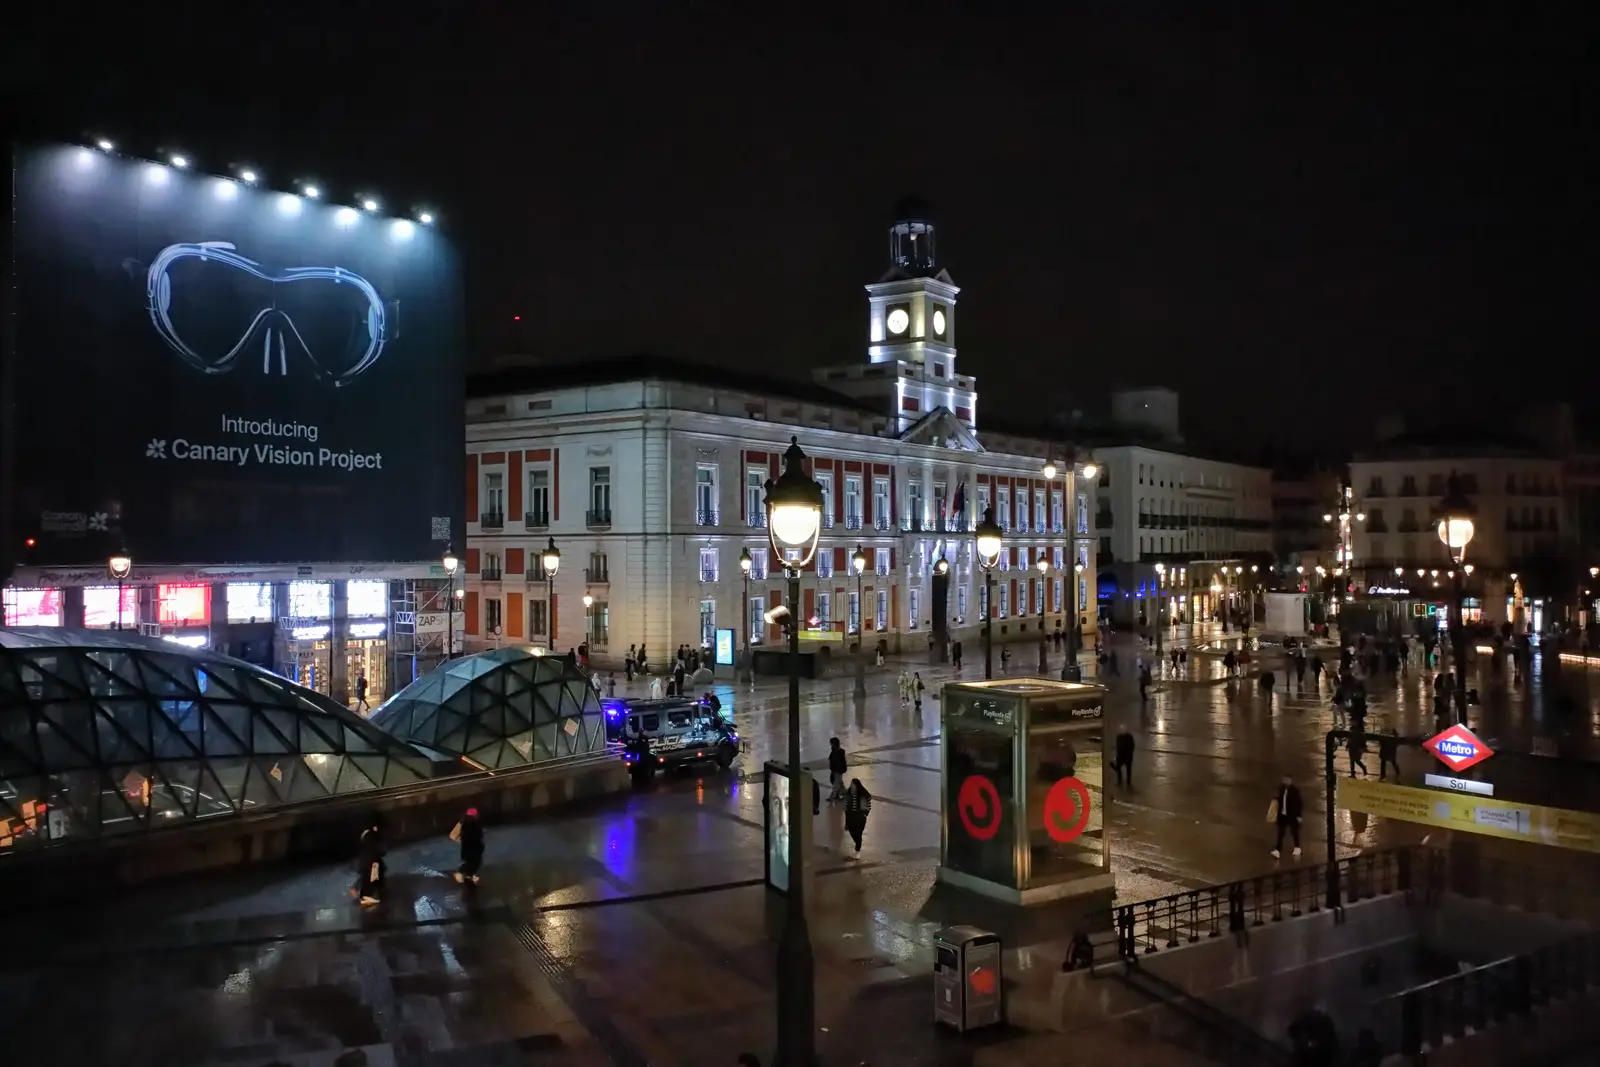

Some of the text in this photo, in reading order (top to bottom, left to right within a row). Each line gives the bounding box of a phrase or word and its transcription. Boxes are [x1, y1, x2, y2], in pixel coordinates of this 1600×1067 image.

[222, 414, 318, 442] Introducing
[172, 438, 383, 472] Canary Vision Project
[1441, 742, 1472, 755] Metro
[1450, 778, 1467, 790] Sol
